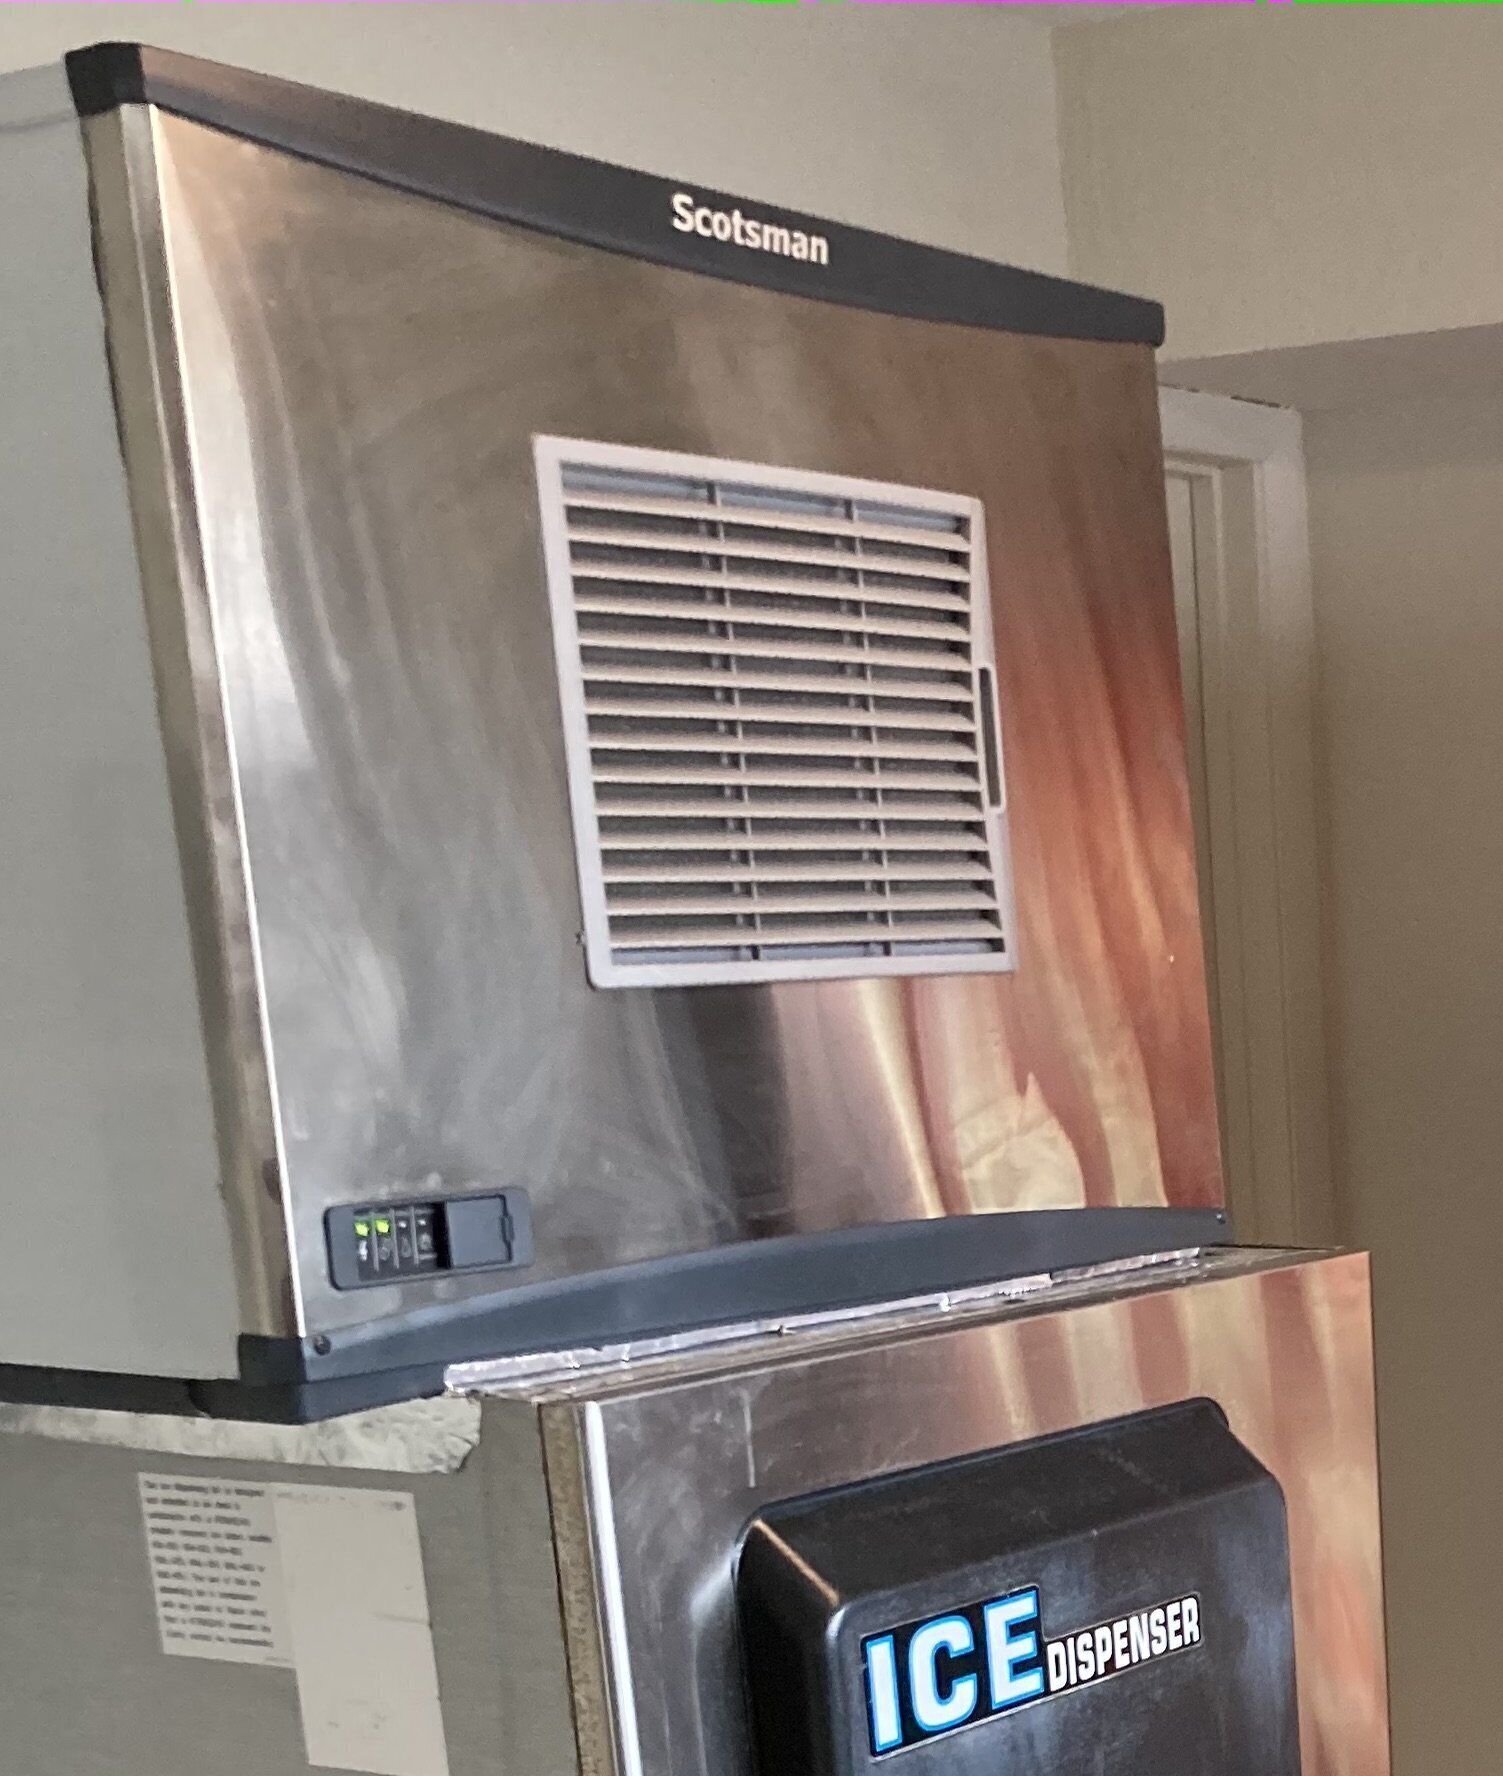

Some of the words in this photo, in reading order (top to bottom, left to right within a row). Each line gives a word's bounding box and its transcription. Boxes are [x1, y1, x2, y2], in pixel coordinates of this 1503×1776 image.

[671, 191, 829, 266] Scotsman
[865, 1589, 1045, 1754] ICE
[1046, 1596, 1201, 1693] DISPENSER
